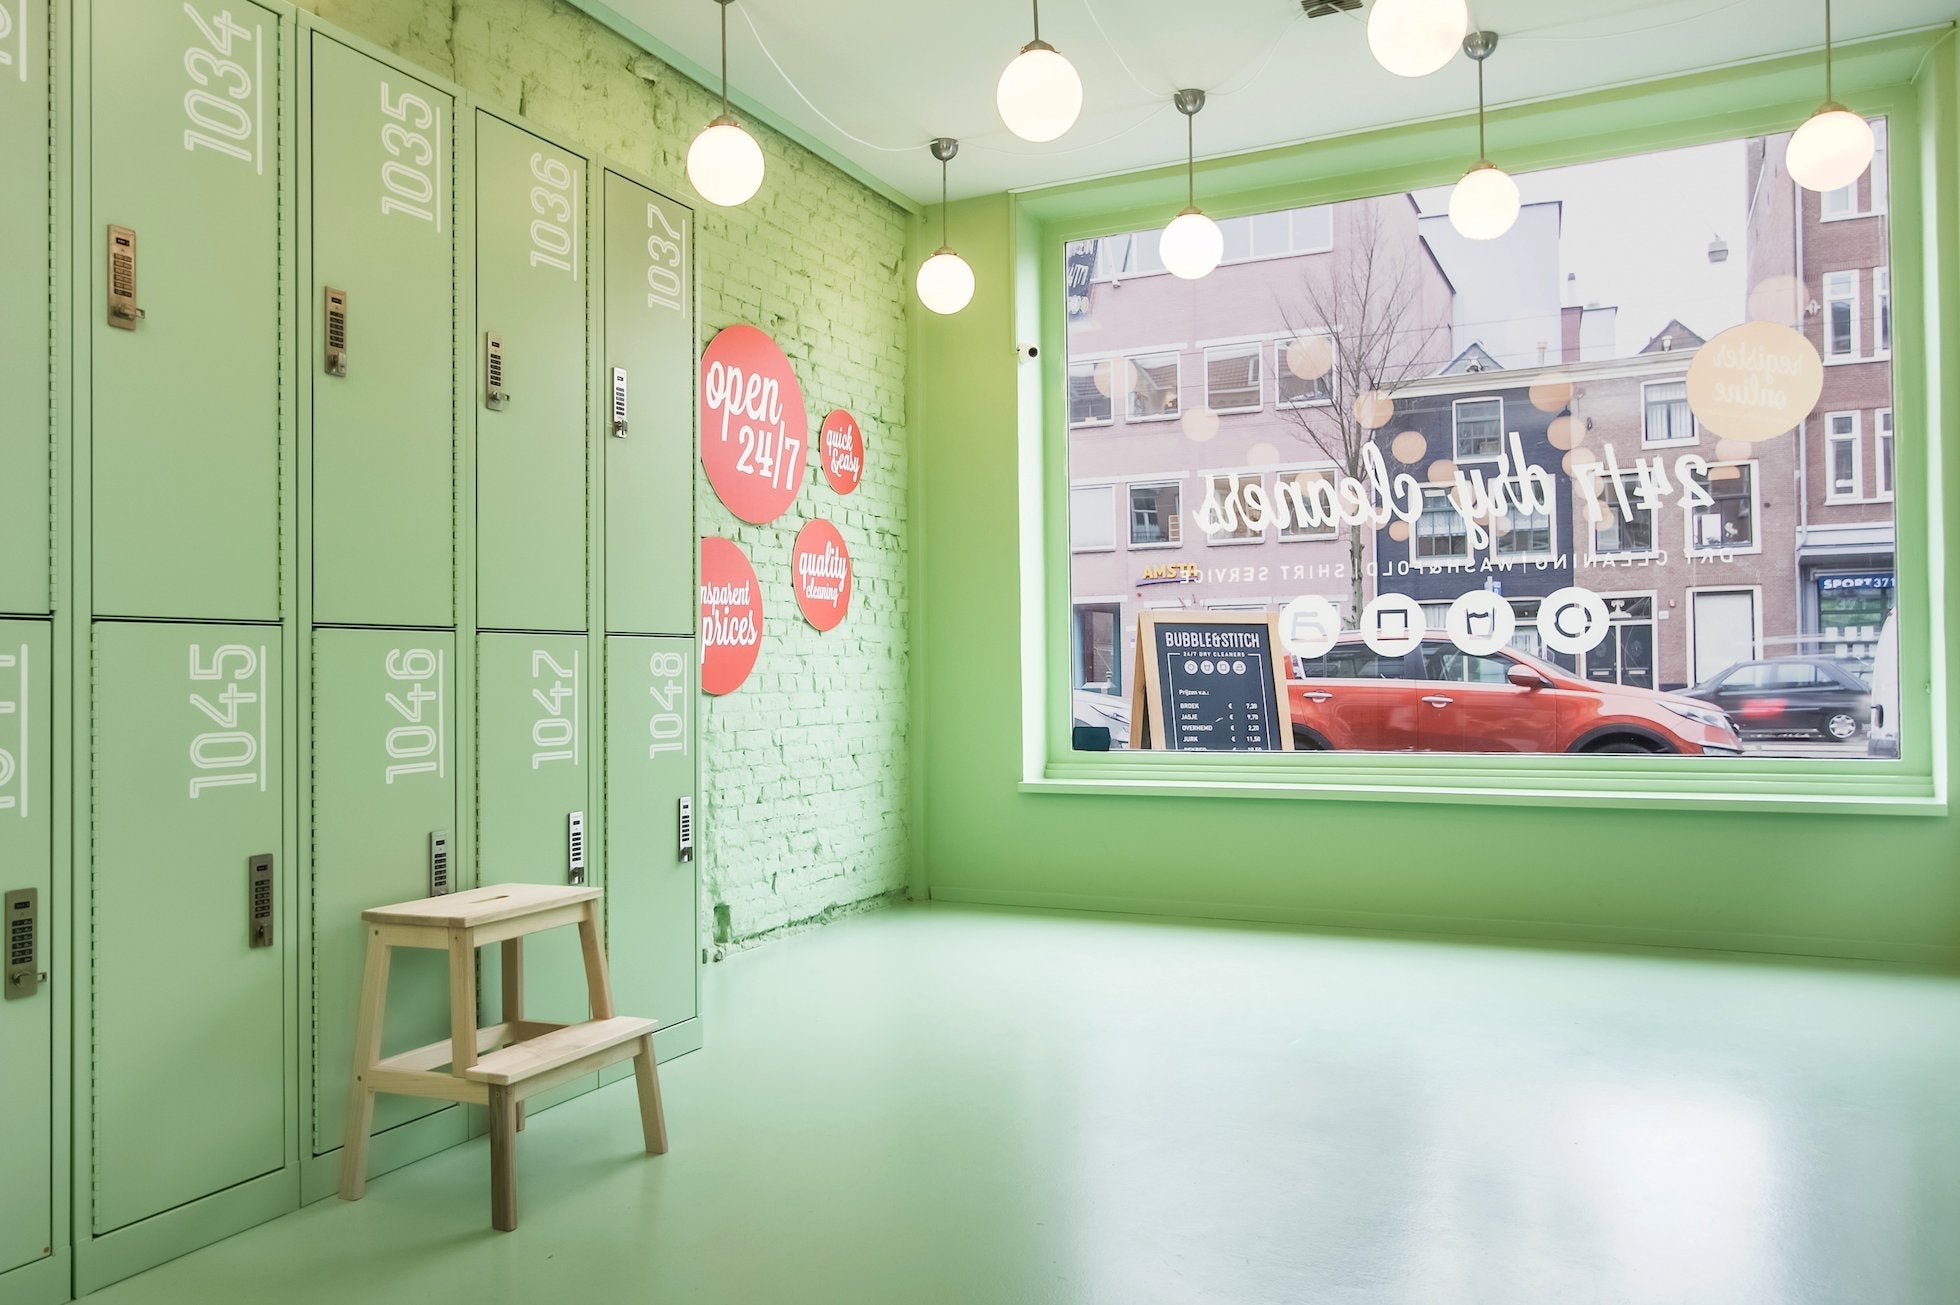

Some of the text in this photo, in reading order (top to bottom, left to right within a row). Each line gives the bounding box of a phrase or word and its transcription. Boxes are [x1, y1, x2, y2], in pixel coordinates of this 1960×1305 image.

[184, 2, 252, 162] 1034
[381, 82, 434, 222] 1035
[530, 152, 571, 272] 1036
[648, 203, 681, 312] 1037
[706, 360, 784, 441] open
[826, 424, 853, 456] quick
[736, 420, 801, 491] 24/7
[831, 449, 860, 482] &easy
[799, 540, 847, 592] quality
[806, 577, 839, 608] cleaning
[701, 606, 758, 665] prices
[1165, 631, 1260, 648] BUBBLE&STITCH
[190, 644, 257, 798] 1045
[386, 648, 436, 784] 1046
[532, 650, 573, 769] 1047
[649, 651, 684, 759] 1048
